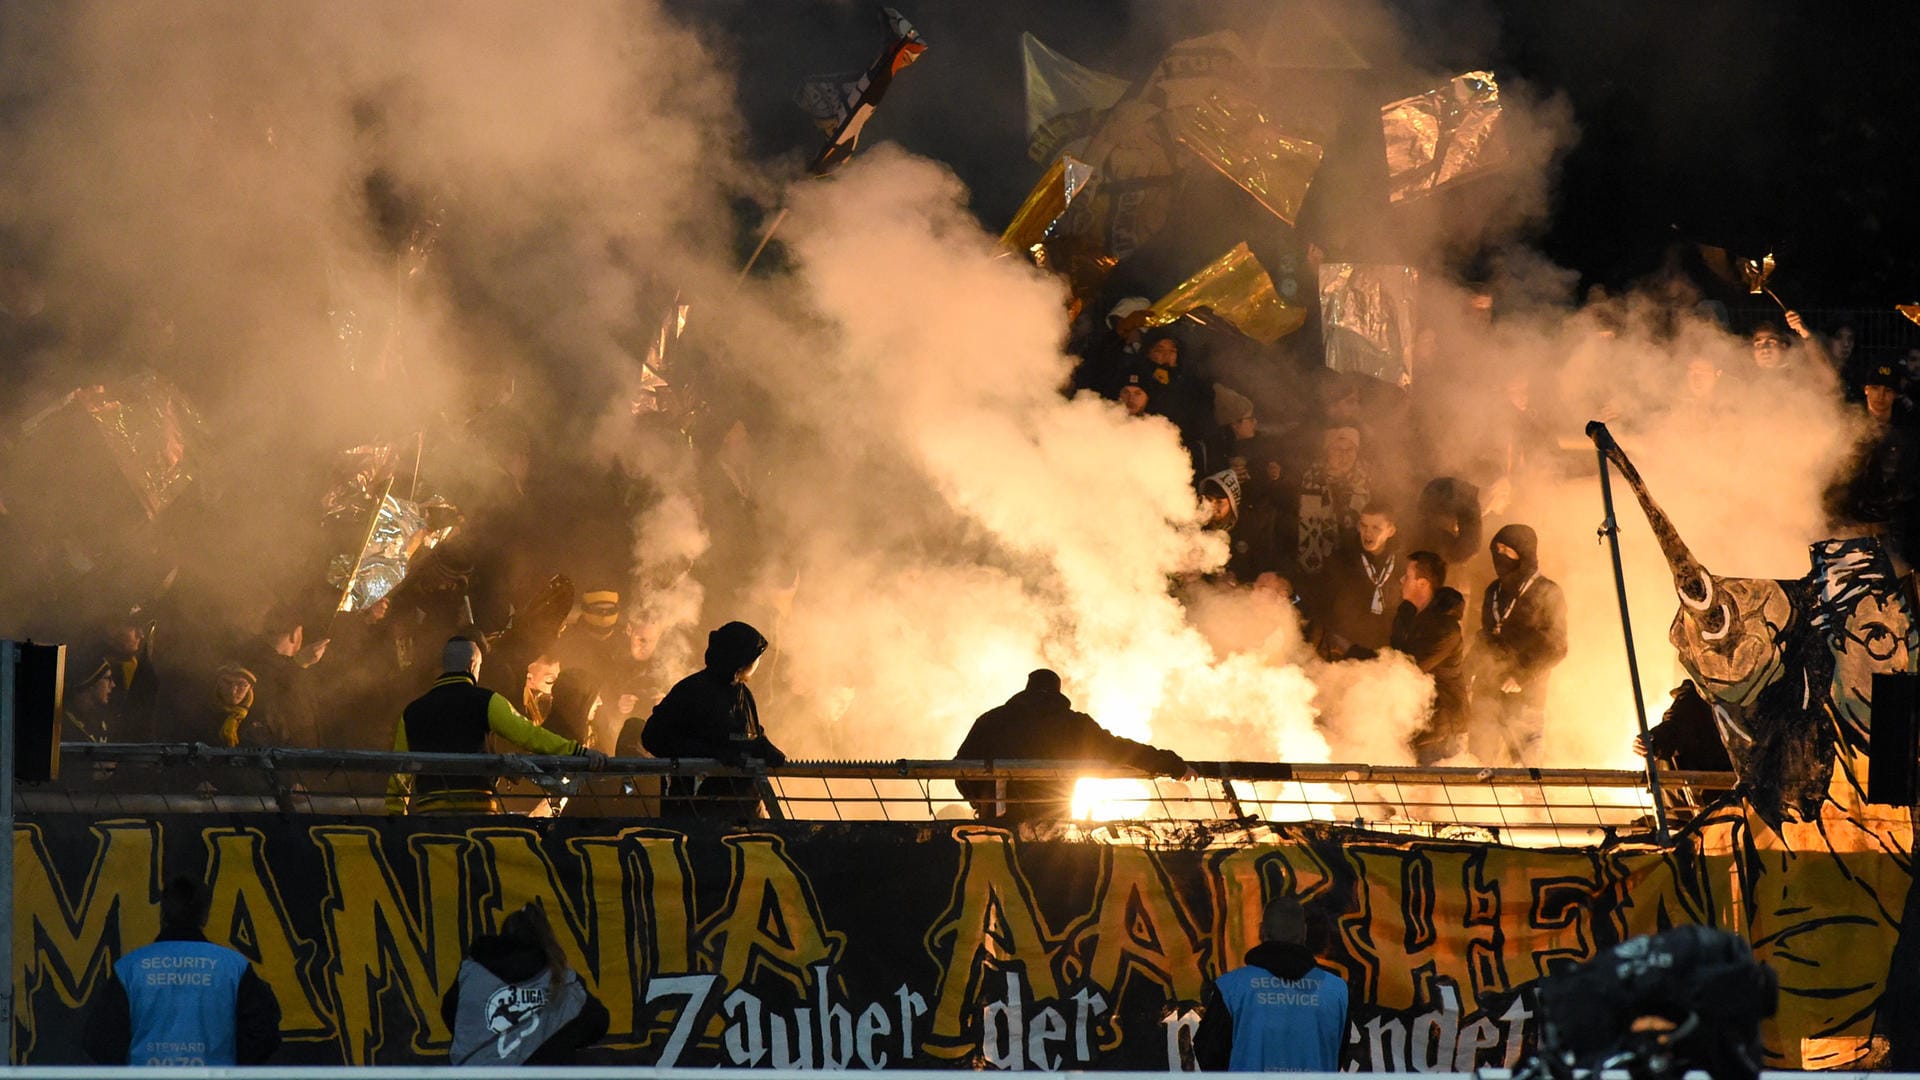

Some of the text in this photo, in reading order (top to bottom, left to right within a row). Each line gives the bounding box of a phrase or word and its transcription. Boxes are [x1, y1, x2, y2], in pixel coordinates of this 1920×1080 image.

[142, 957, 217, 969] SECURITY
[147, 973, 212, 986] SERVICE
[1250, 977, 1321, 990] SECURITY
[1257, 992, 1319, 1006] SERVICE
[645, 965, 927, 1070] Zauber
[982, 972, 1108, 1071] der
[146, 1042, 206, 1053] STEWARD
